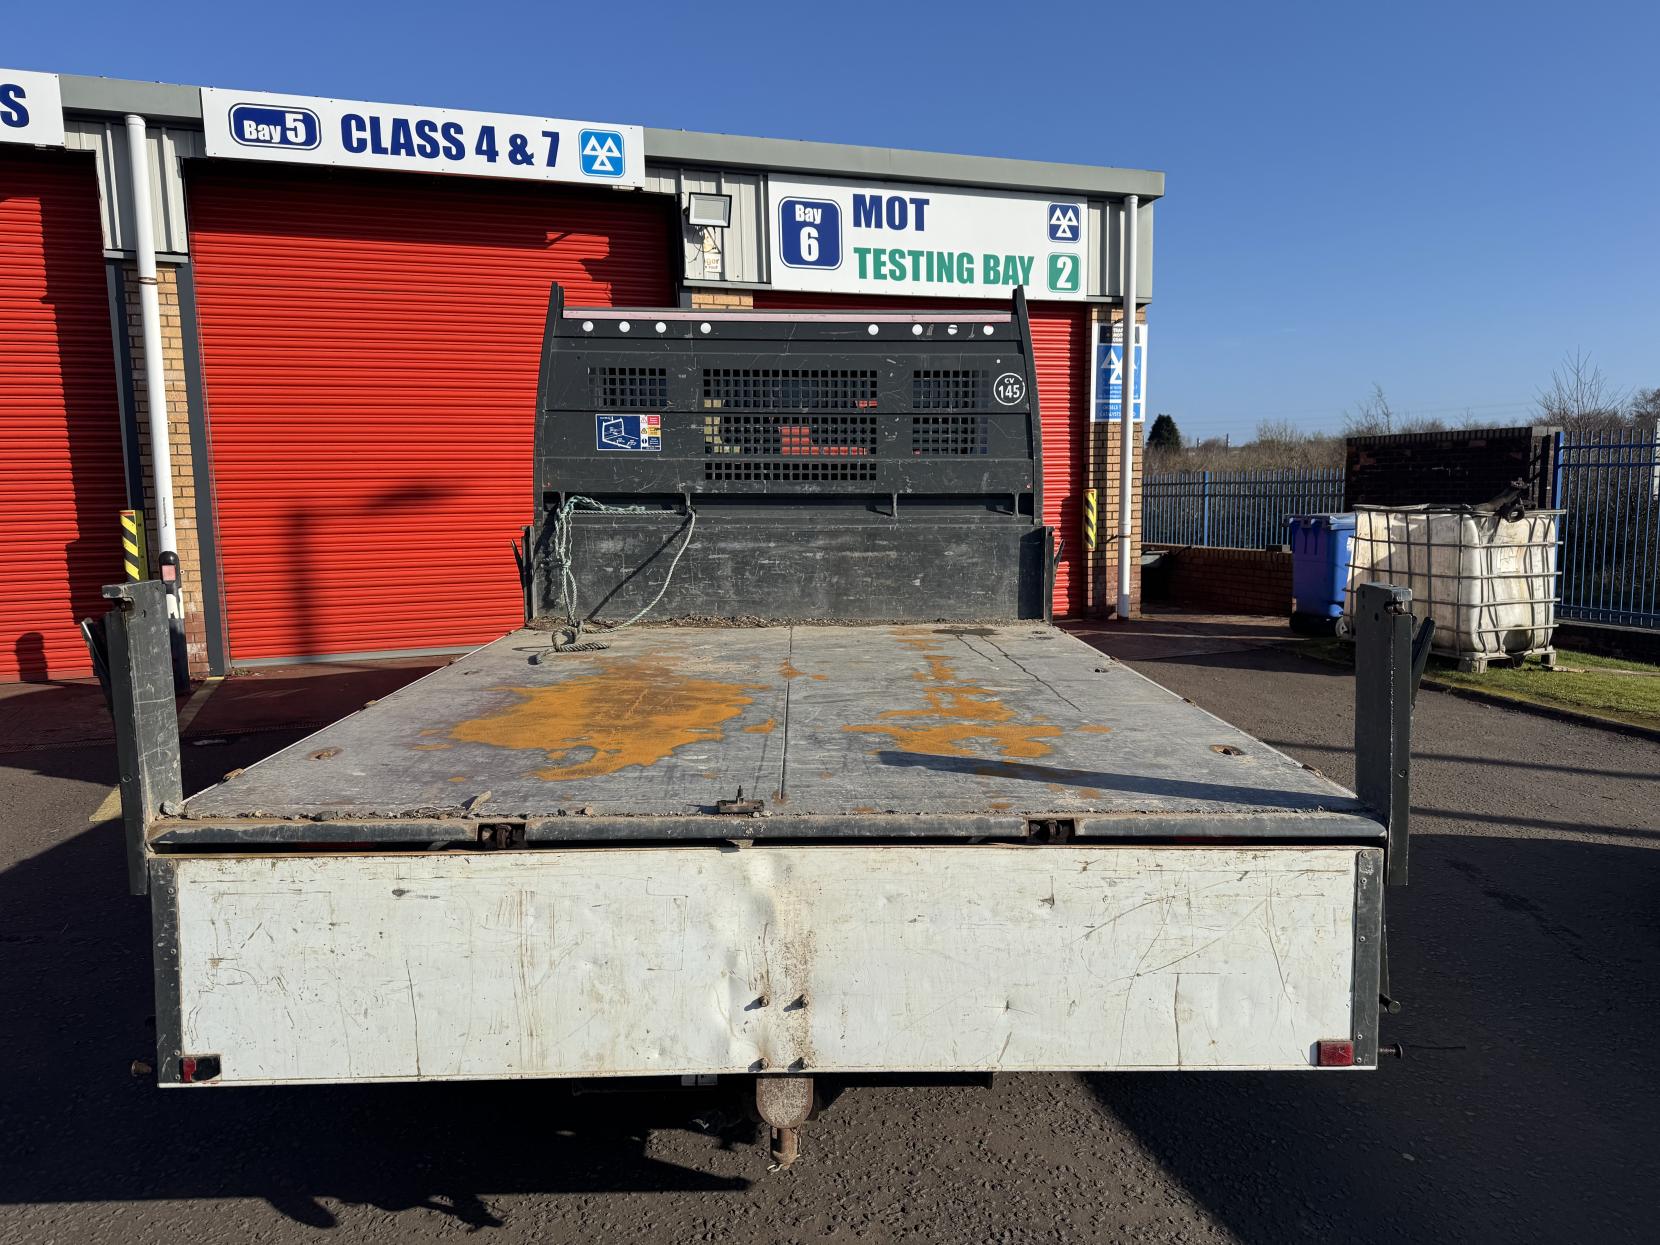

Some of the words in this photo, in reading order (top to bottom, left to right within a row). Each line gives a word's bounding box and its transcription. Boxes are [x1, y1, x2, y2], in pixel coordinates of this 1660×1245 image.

[0, 83, 29, 128] S
[243, 119, 281, 143] Bay
[285, 114, 307, 144] 5
[341, 113, 466, 161] CLASS
[475, 125, 499, 163] 4
[508, 133, 535, 166] &
[541, 130, 560, 168] 7
[794, 203, 822, 225] Bay
[852, 193, 930, 232] MOT
[799, 226, 820, 262] 6
[853, 246, 975, 284] TESTING
[982, 253, 1035, 286] BAY
[1056, 255, 1073, 289] 2
[998, 384, 1020, 399] 145
